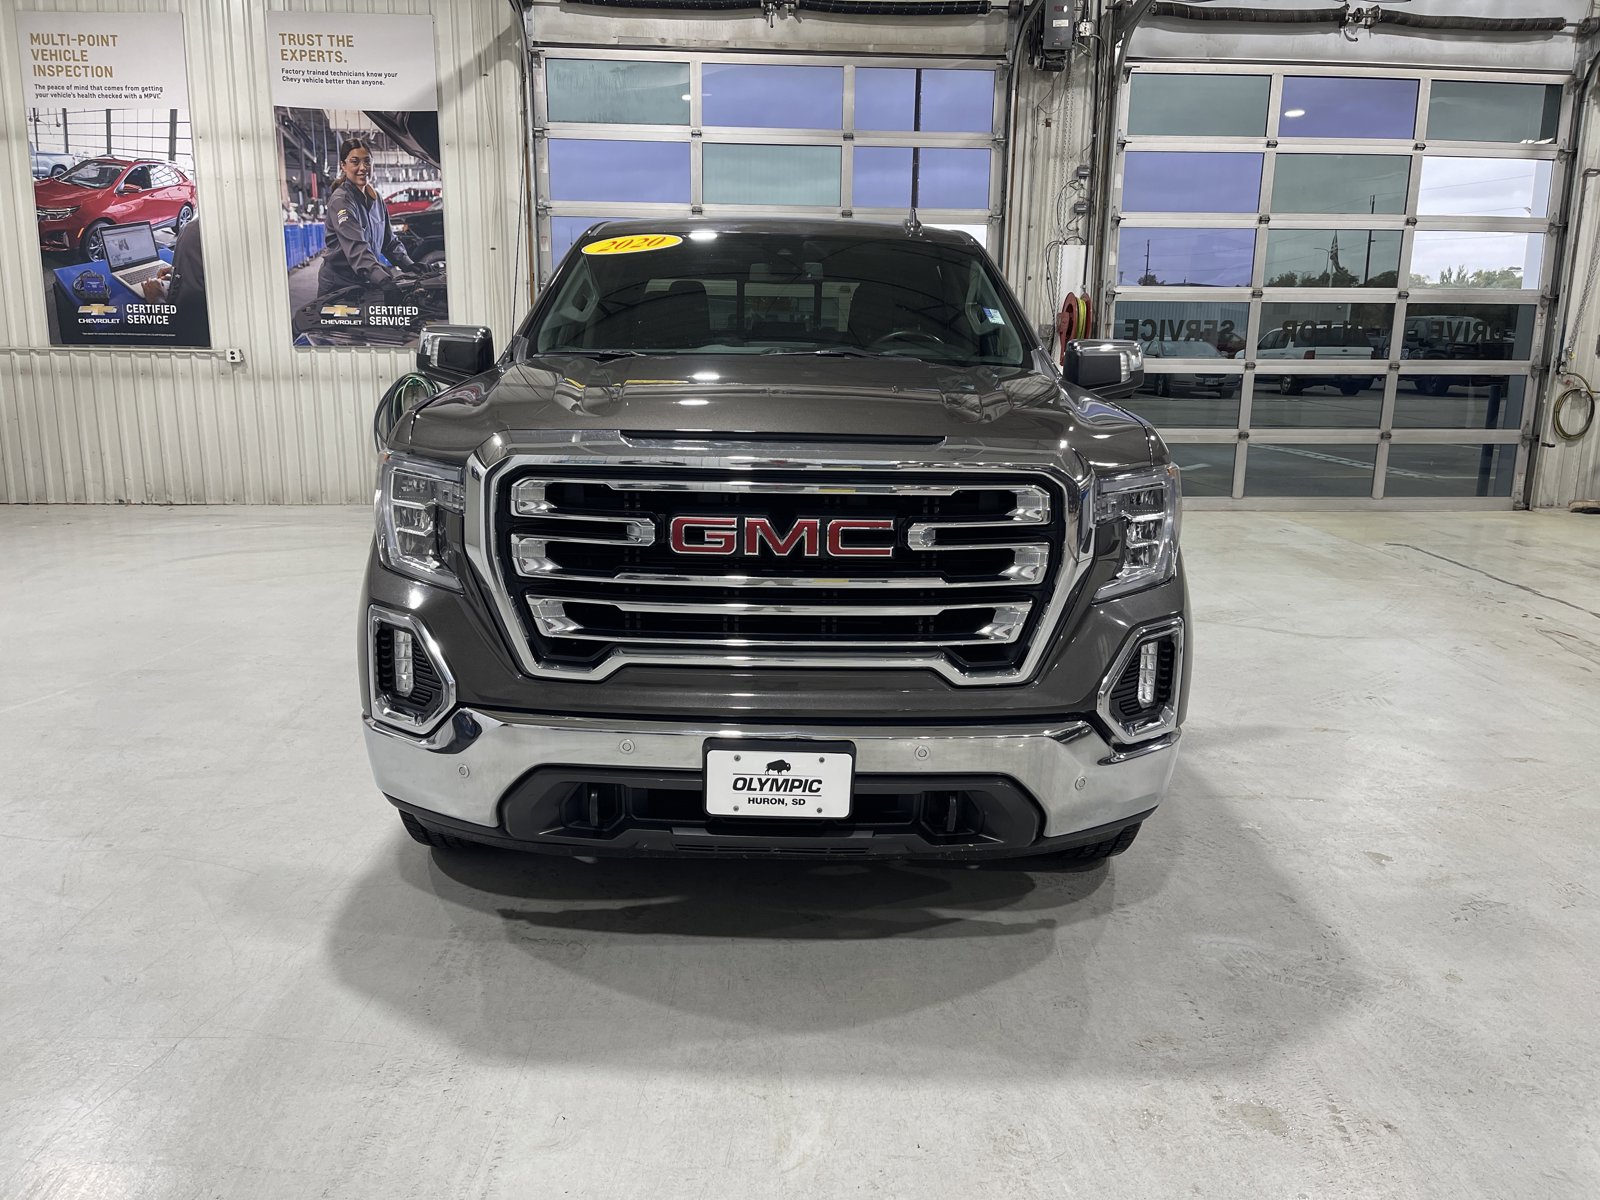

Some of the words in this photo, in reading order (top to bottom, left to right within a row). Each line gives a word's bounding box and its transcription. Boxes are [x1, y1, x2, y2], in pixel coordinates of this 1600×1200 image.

[30, 33, 118, 47] MULTI-POINT
[279, 33, 323, 47] TRUST
[327, 34, 354, 48] THE
[31, 49, 89, 62] VEHICLE
[280, 49, 348, 63] EXPERTS.
[33, 64, 114, 78] INSPECTION
[281, 68, 305, 76] Factory
[330, 69, 365, 77] technicians
[366, 70, 383, 78] know
[282, 76, 301, 84] Chevy
[141, 85, 163, 93] getting
[50, 91, 76, 99] vehicle's
[597, 237, 667, 252] 2020
[126, 304, 177, 314] CERTIFIED
[368, 306, 418, 316] CERTIFIED
[127, 314, 169, 325] SERVICE
[369, 317, 411, 326] SERVICE
[670, 516, 895, 558] GMC
[732, 777, 823, 794] OLYMPIC
[747, 797, 788, 807] HURON,
[791, 798, 806, 806] SD
